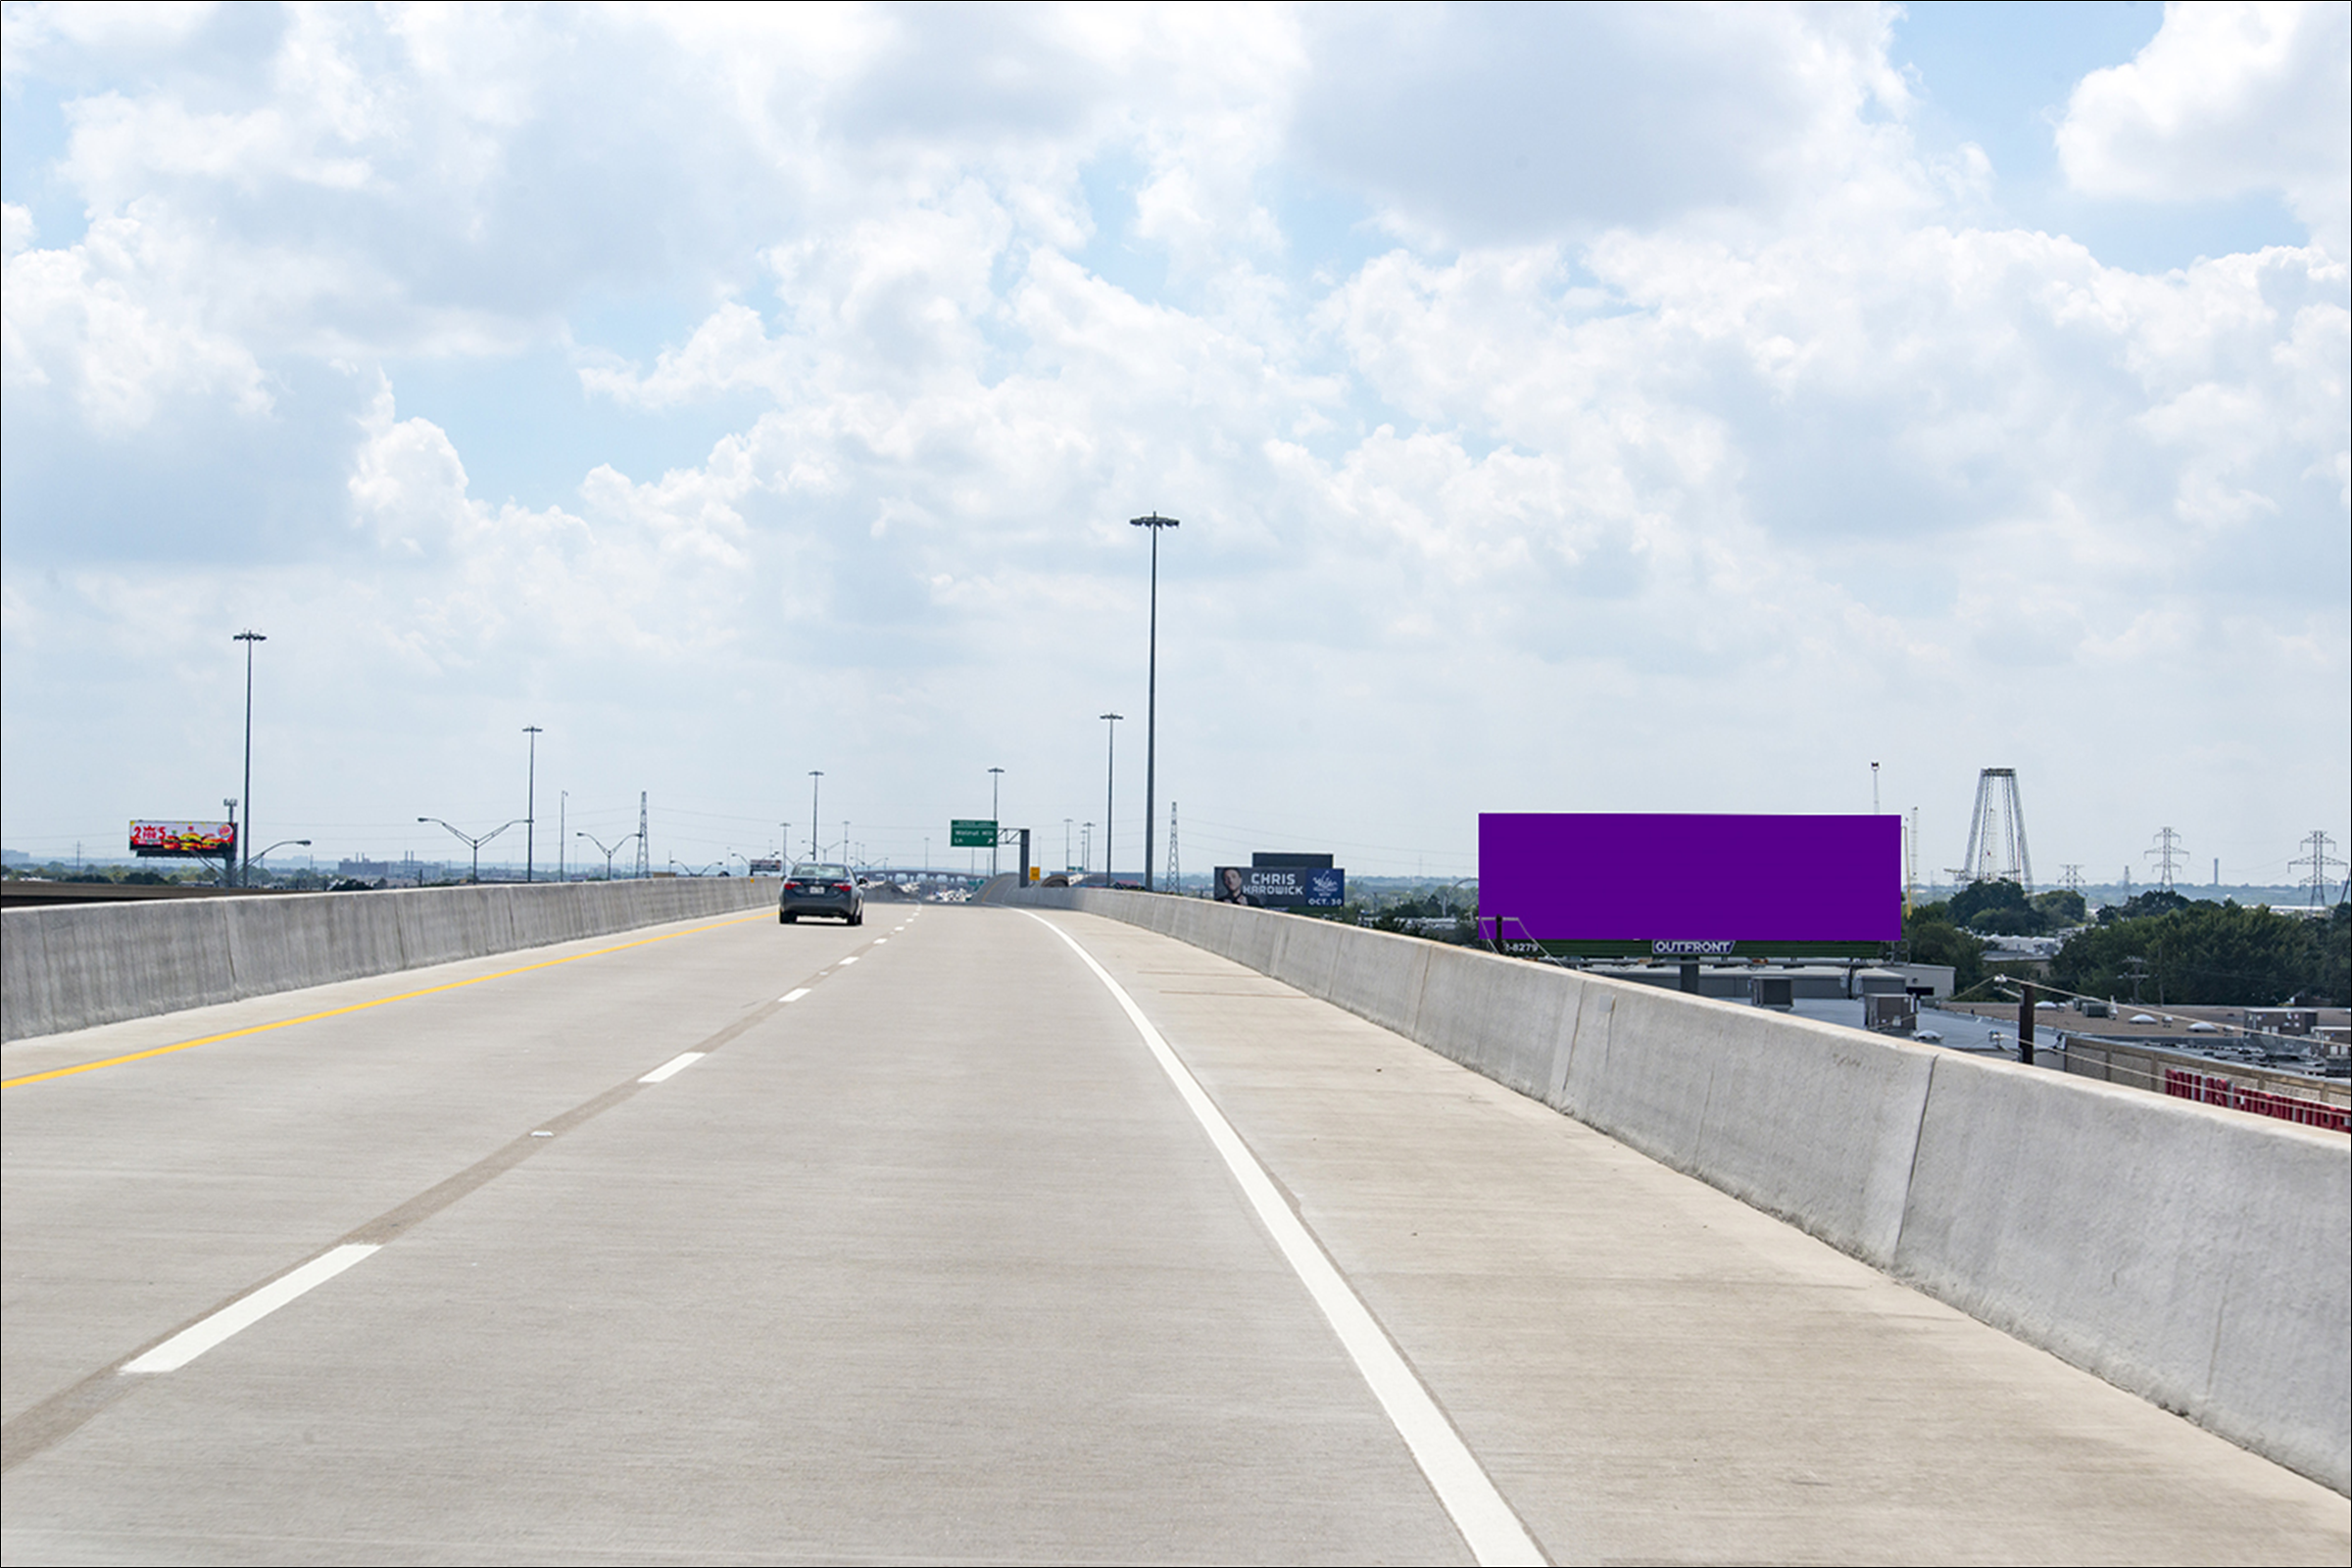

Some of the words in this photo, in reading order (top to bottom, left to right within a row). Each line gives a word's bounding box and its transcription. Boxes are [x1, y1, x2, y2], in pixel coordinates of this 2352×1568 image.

[133, 825, 142, 840] 2
[1250, 873, 1297, 886] CHRIS
[1242, 885, 1304, 896] HARDWICK
[1654, 941, 1732, 954] OUTFRONT
